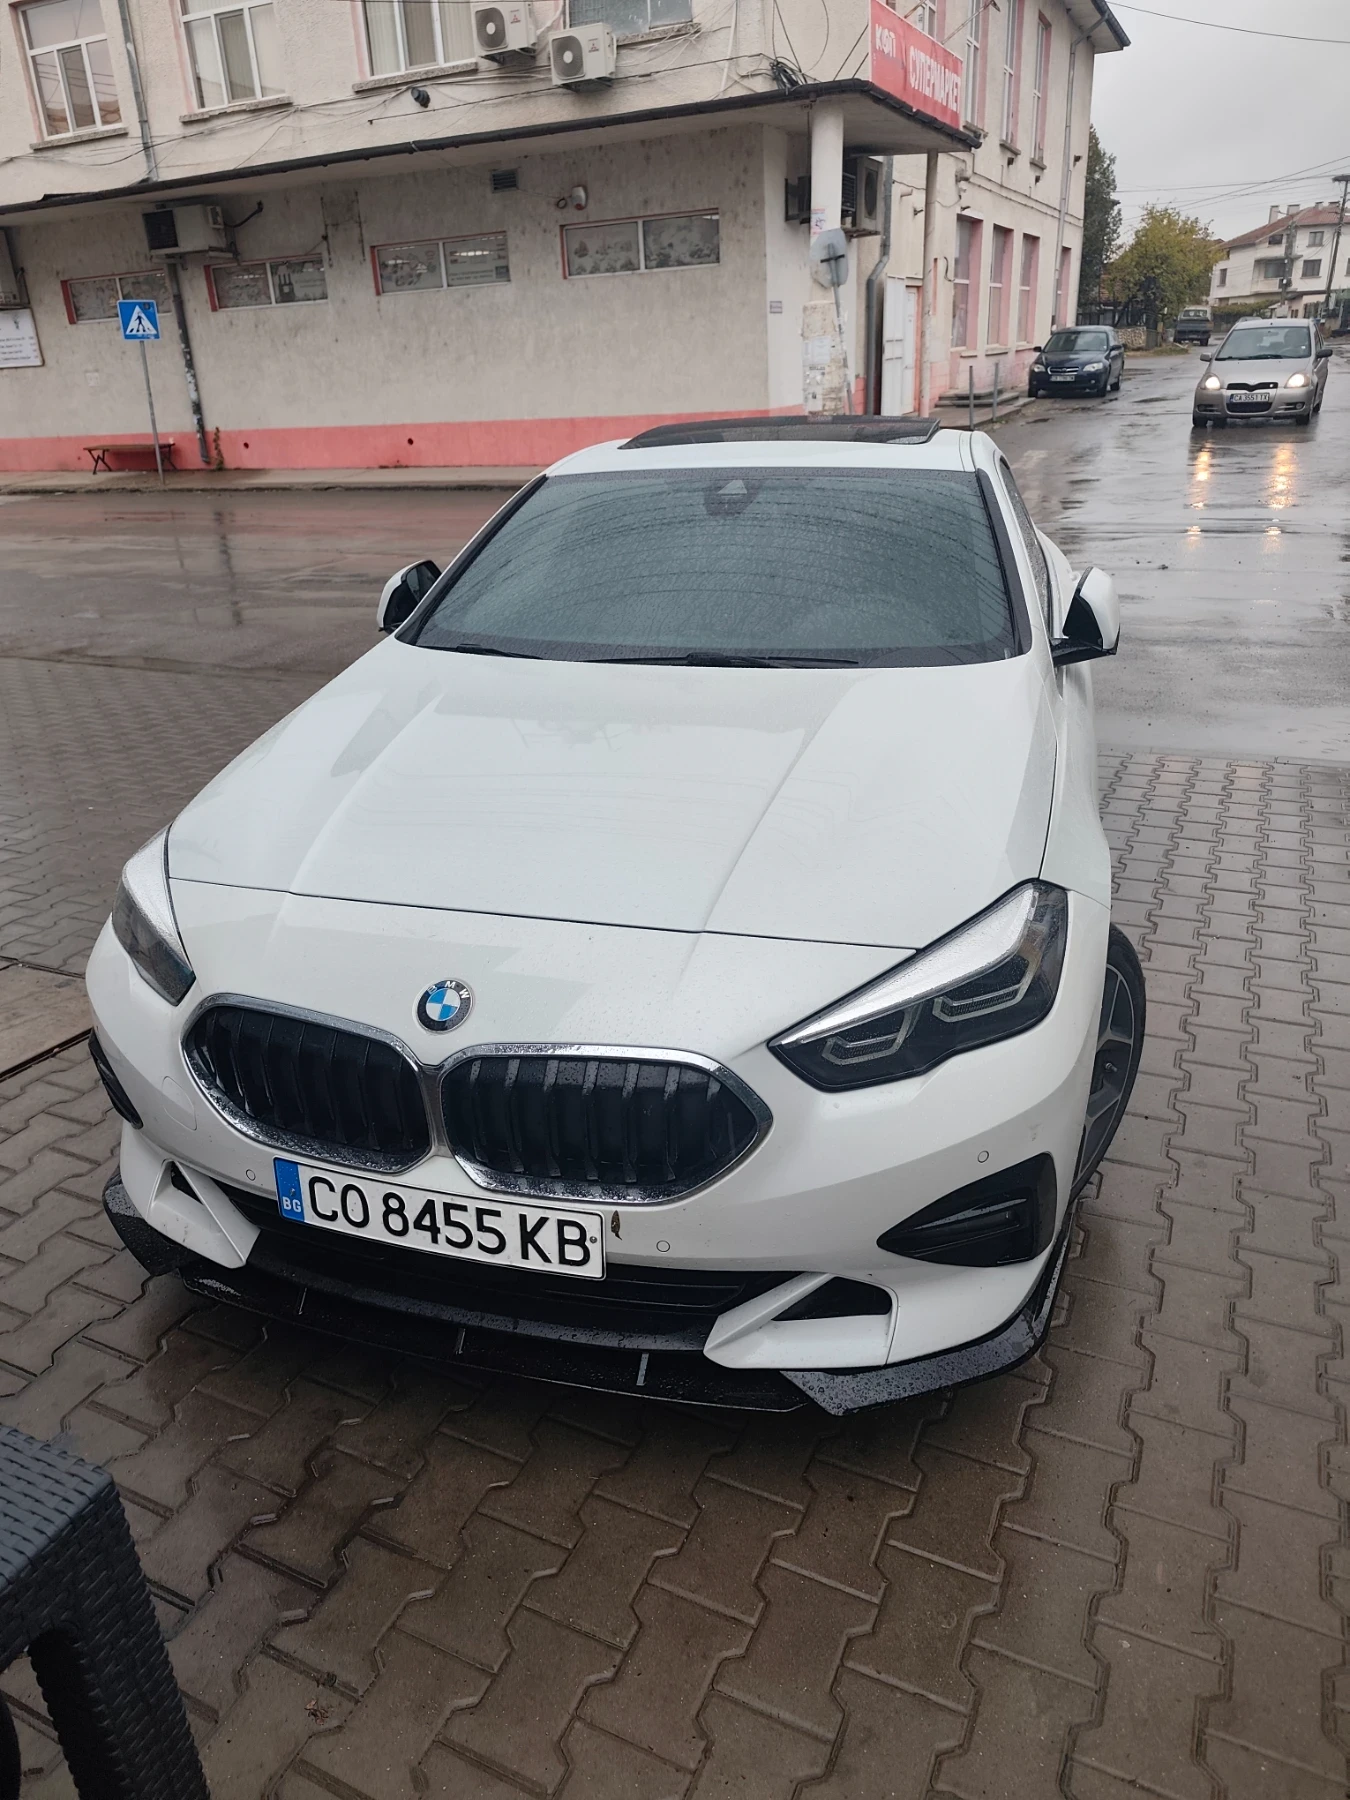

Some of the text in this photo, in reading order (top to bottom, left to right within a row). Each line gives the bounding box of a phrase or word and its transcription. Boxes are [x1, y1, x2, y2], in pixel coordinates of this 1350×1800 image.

[909, 45, 961, 114] СУПЕРМАРКЕТ
[427, 980, 470, 999] BMW
[282, 1195, 302, 1213] BG
[308, 1176, 591, 1267] CO 8455 KB
